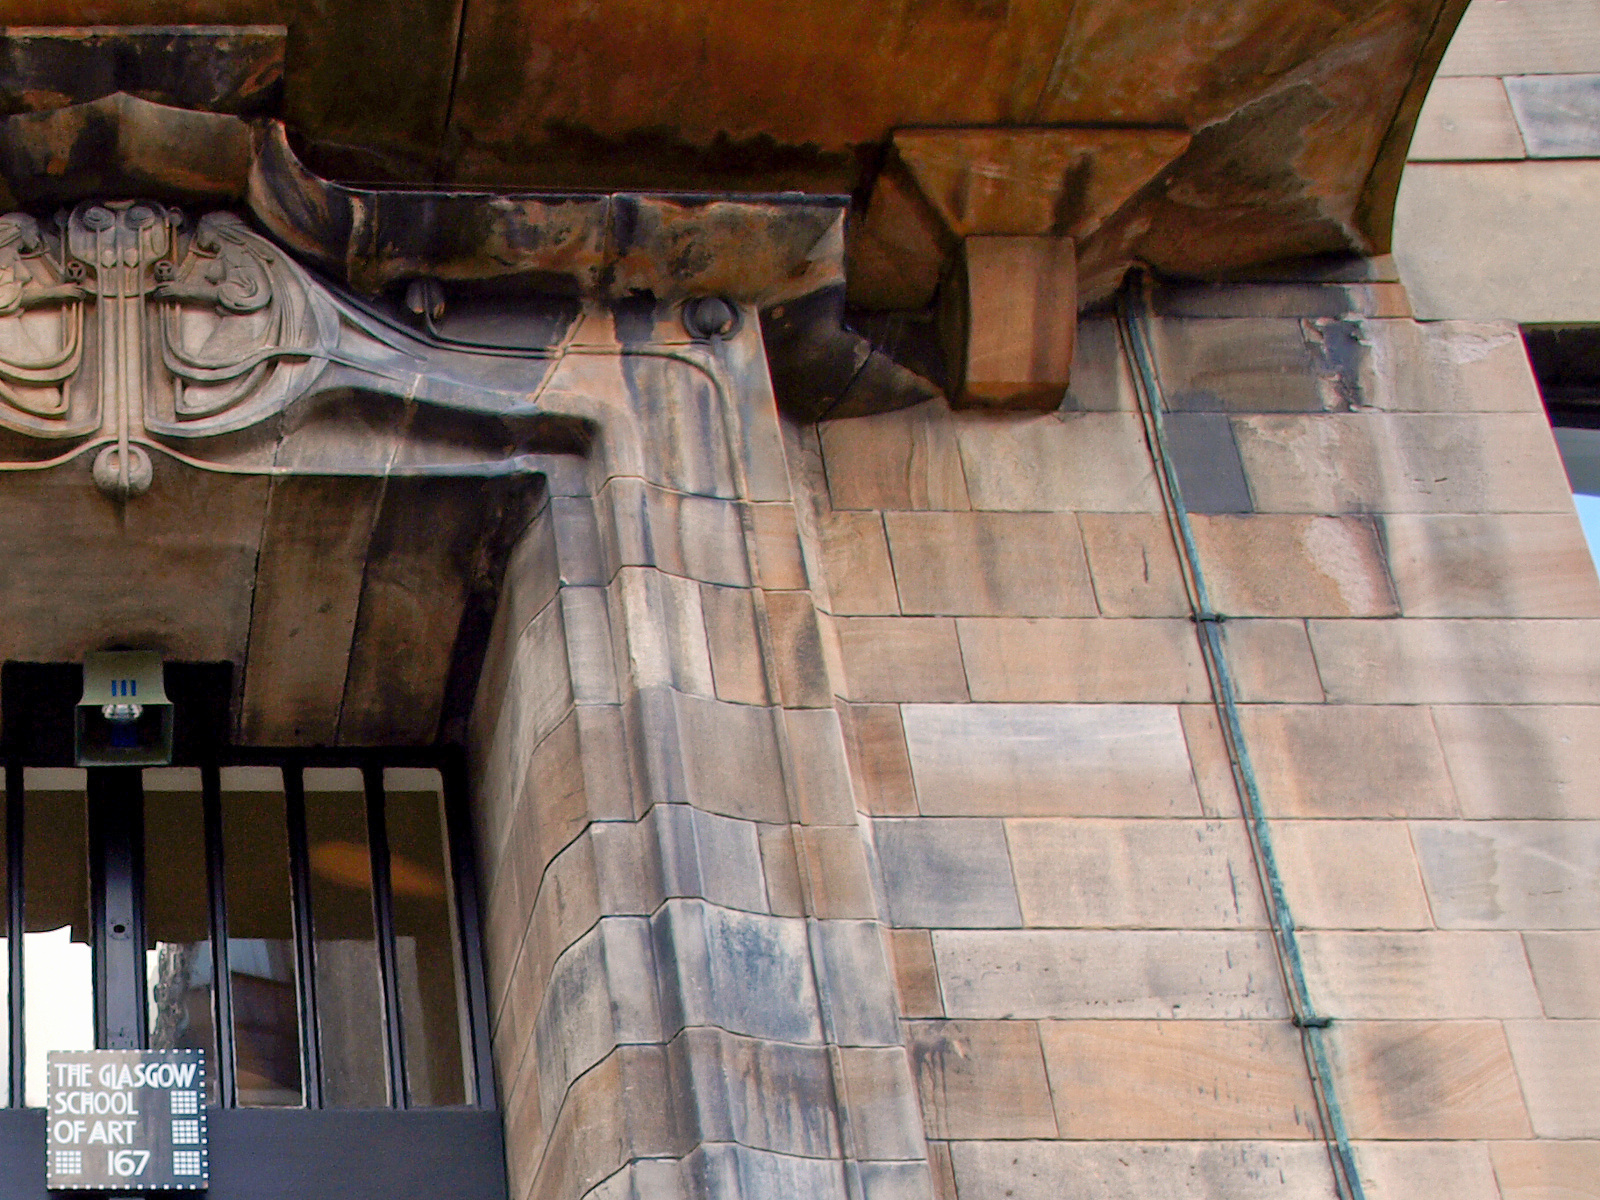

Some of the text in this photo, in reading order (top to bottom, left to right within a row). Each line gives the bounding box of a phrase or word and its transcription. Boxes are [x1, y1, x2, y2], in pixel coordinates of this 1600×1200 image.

[54, 1063, 197, 1090] THE GLASGOW
[54, 1091, 139, 1115] SCHOOL
[53, 1120, 137, 1144] OF ART
[107, 1150, 151, 1176] 167
